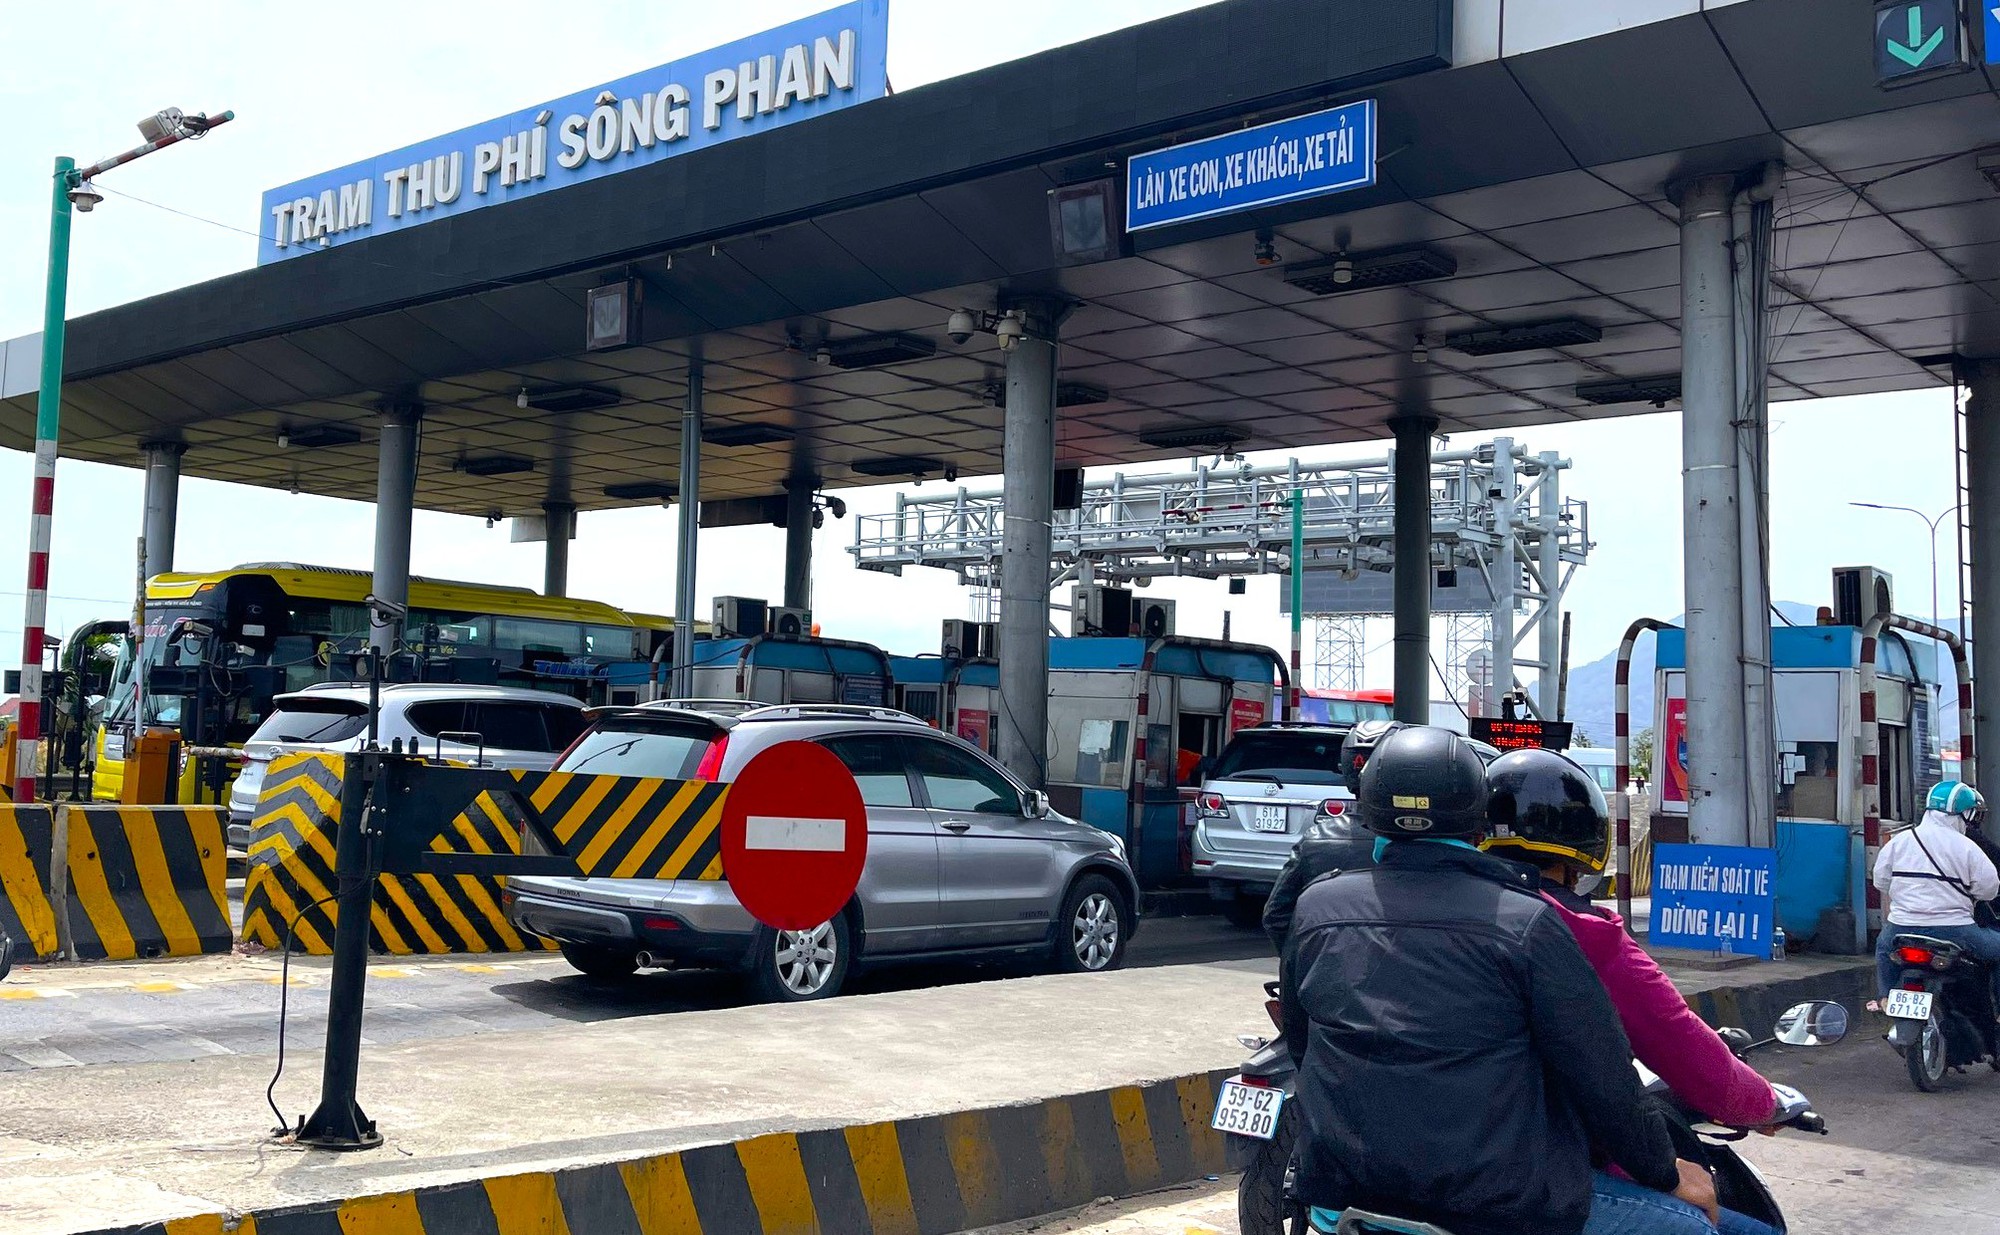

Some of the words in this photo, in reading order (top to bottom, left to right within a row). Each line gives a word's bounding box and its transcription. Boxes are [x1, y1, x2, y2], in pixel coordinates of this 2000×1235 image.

[272, 178, 373, 248] TRẠM
[384, 150, 464, 218] THU
[472, 110, 553, 194] PHÍ
[556, 90, 691, 170] SÔNG
[702, 28, 857, 130] PHAN
[1136, 167, 1164, 210] LÀN
[1168, 166, 1187, 202] XE
[1326, 114, 1354, 166] TẢI
[1262, 807, 1278, 818] 61A
[1660, 864, 1689, 895] TRẠM
[1690, 856, 1720, 892] KIỂM
[1722, 863, 1751, 895] SOÁT
[1754, 864, 1769, 896] VÉ
[1660, 902, 1708, 936] DỪNG
[1228, 1086, 1273, 1112] 59-G2
[1218, 1108, 1272, 1134] 953.80
